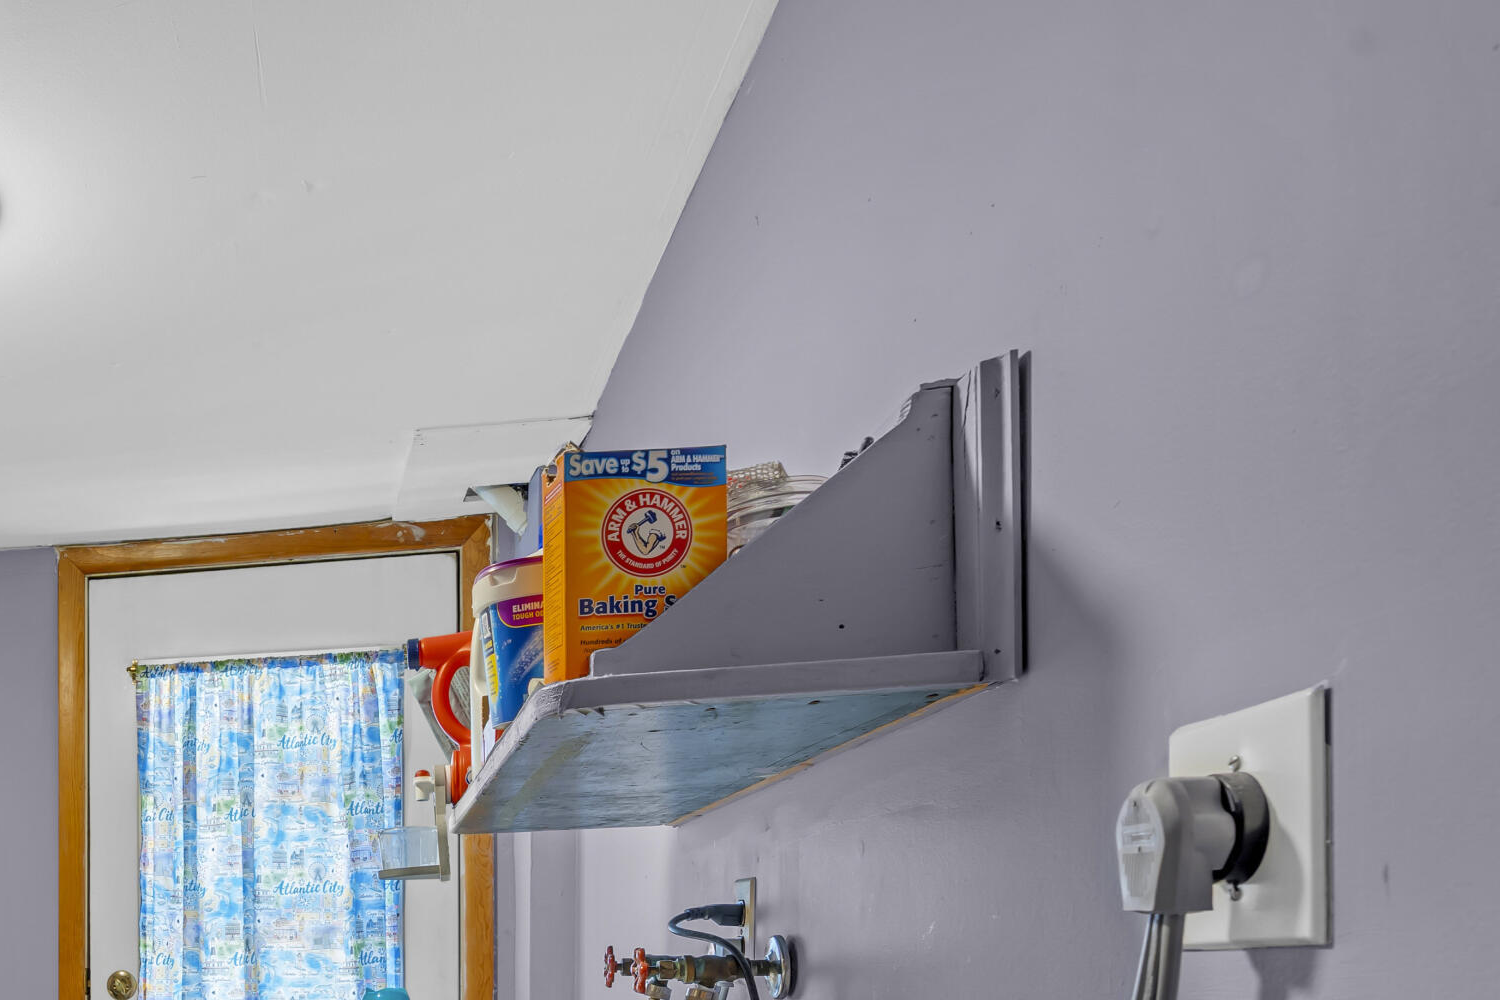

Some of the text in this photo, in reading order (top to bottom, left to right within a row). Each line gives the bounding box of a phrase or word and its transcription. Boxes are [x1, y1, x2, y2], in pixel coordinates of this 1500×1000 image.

[569, 454, 619, 477] Save
[631, 450, 670, 483] $5
[670, 463, 702, 471] Products
[607, 493, 688, 542] ARM & HAMMER
[625, 558, 655, 570] STANDARD
[634, 584, 667, 597] Pure
[512, 601, 544, 613] ELIMINA
[578, 594, 678, 620] Baking S
[512, 612, 534, 621] TOUGH
[580, 623, 614, 631] America's
[626, 622, 648, 630] Truste
[277, 734, 317, 750] Atlantic
[346, 800, 385, 816] Atlanti
[273, 879, 346, 897] Atlantic City
[155, 952, 175, 969] City
[359, 950, 387, 966] Atlan
